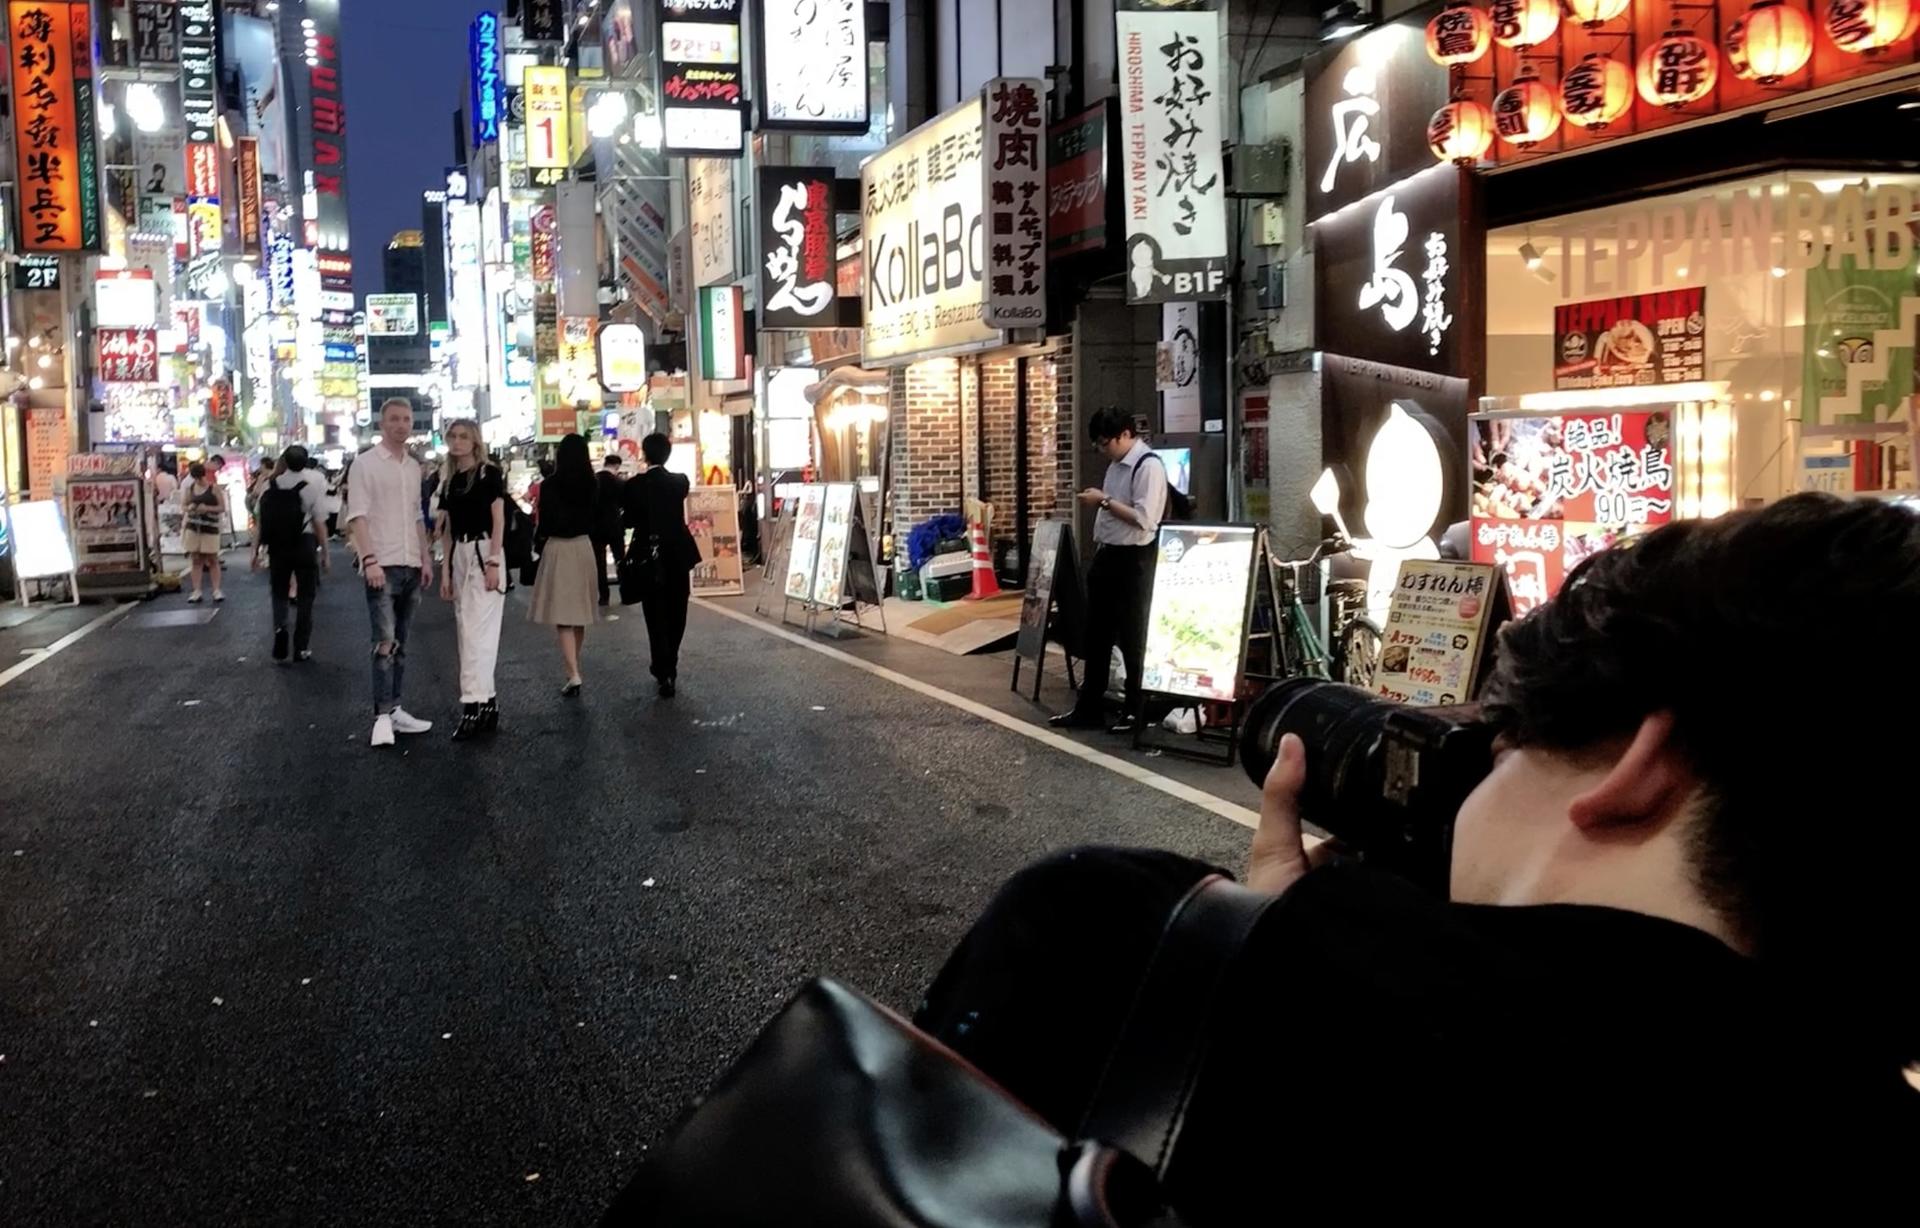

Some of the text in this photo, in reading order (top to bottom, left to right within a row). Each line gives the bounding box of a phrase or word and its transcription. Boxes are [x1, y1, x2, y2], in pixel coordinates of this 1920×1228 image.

[1126, 32, 1145, 114] HIROSHIMA
[1154, 32, 1217, 236] お好み焼き
[535, 168, 564, 184] 4F
[992, 182, 1015, 297] 韓国料理
[1555, 184, 1777, 299] TEPPAN
[27, 268, 58, 288] 2F
[1174, 270, 1225, 294] B1F
[993, 305, 1042, 320] KollaBo
[1550, 446, 1671, 497] 炭火焼鳥
